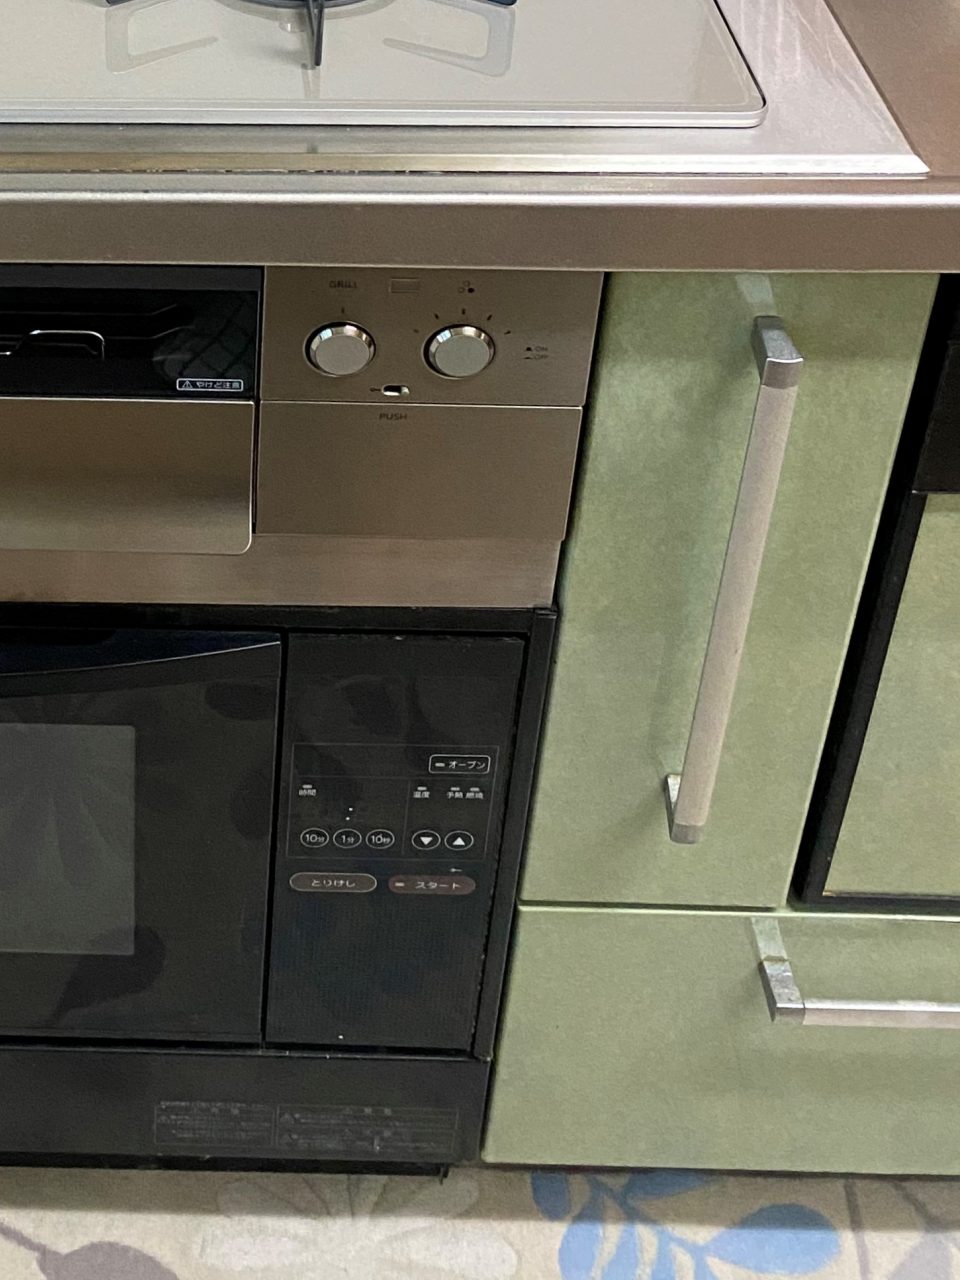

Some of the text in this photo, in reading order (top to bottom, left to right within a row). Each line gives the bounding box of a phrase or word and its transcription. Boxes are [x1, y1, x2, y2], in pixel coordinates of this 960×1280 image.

[379, 412, 408, 420] PUSH
[448, 760, 486, 770] オープン
[311, 878, 356, 888] とりけし
[415, 880, 462, 890] スタート
